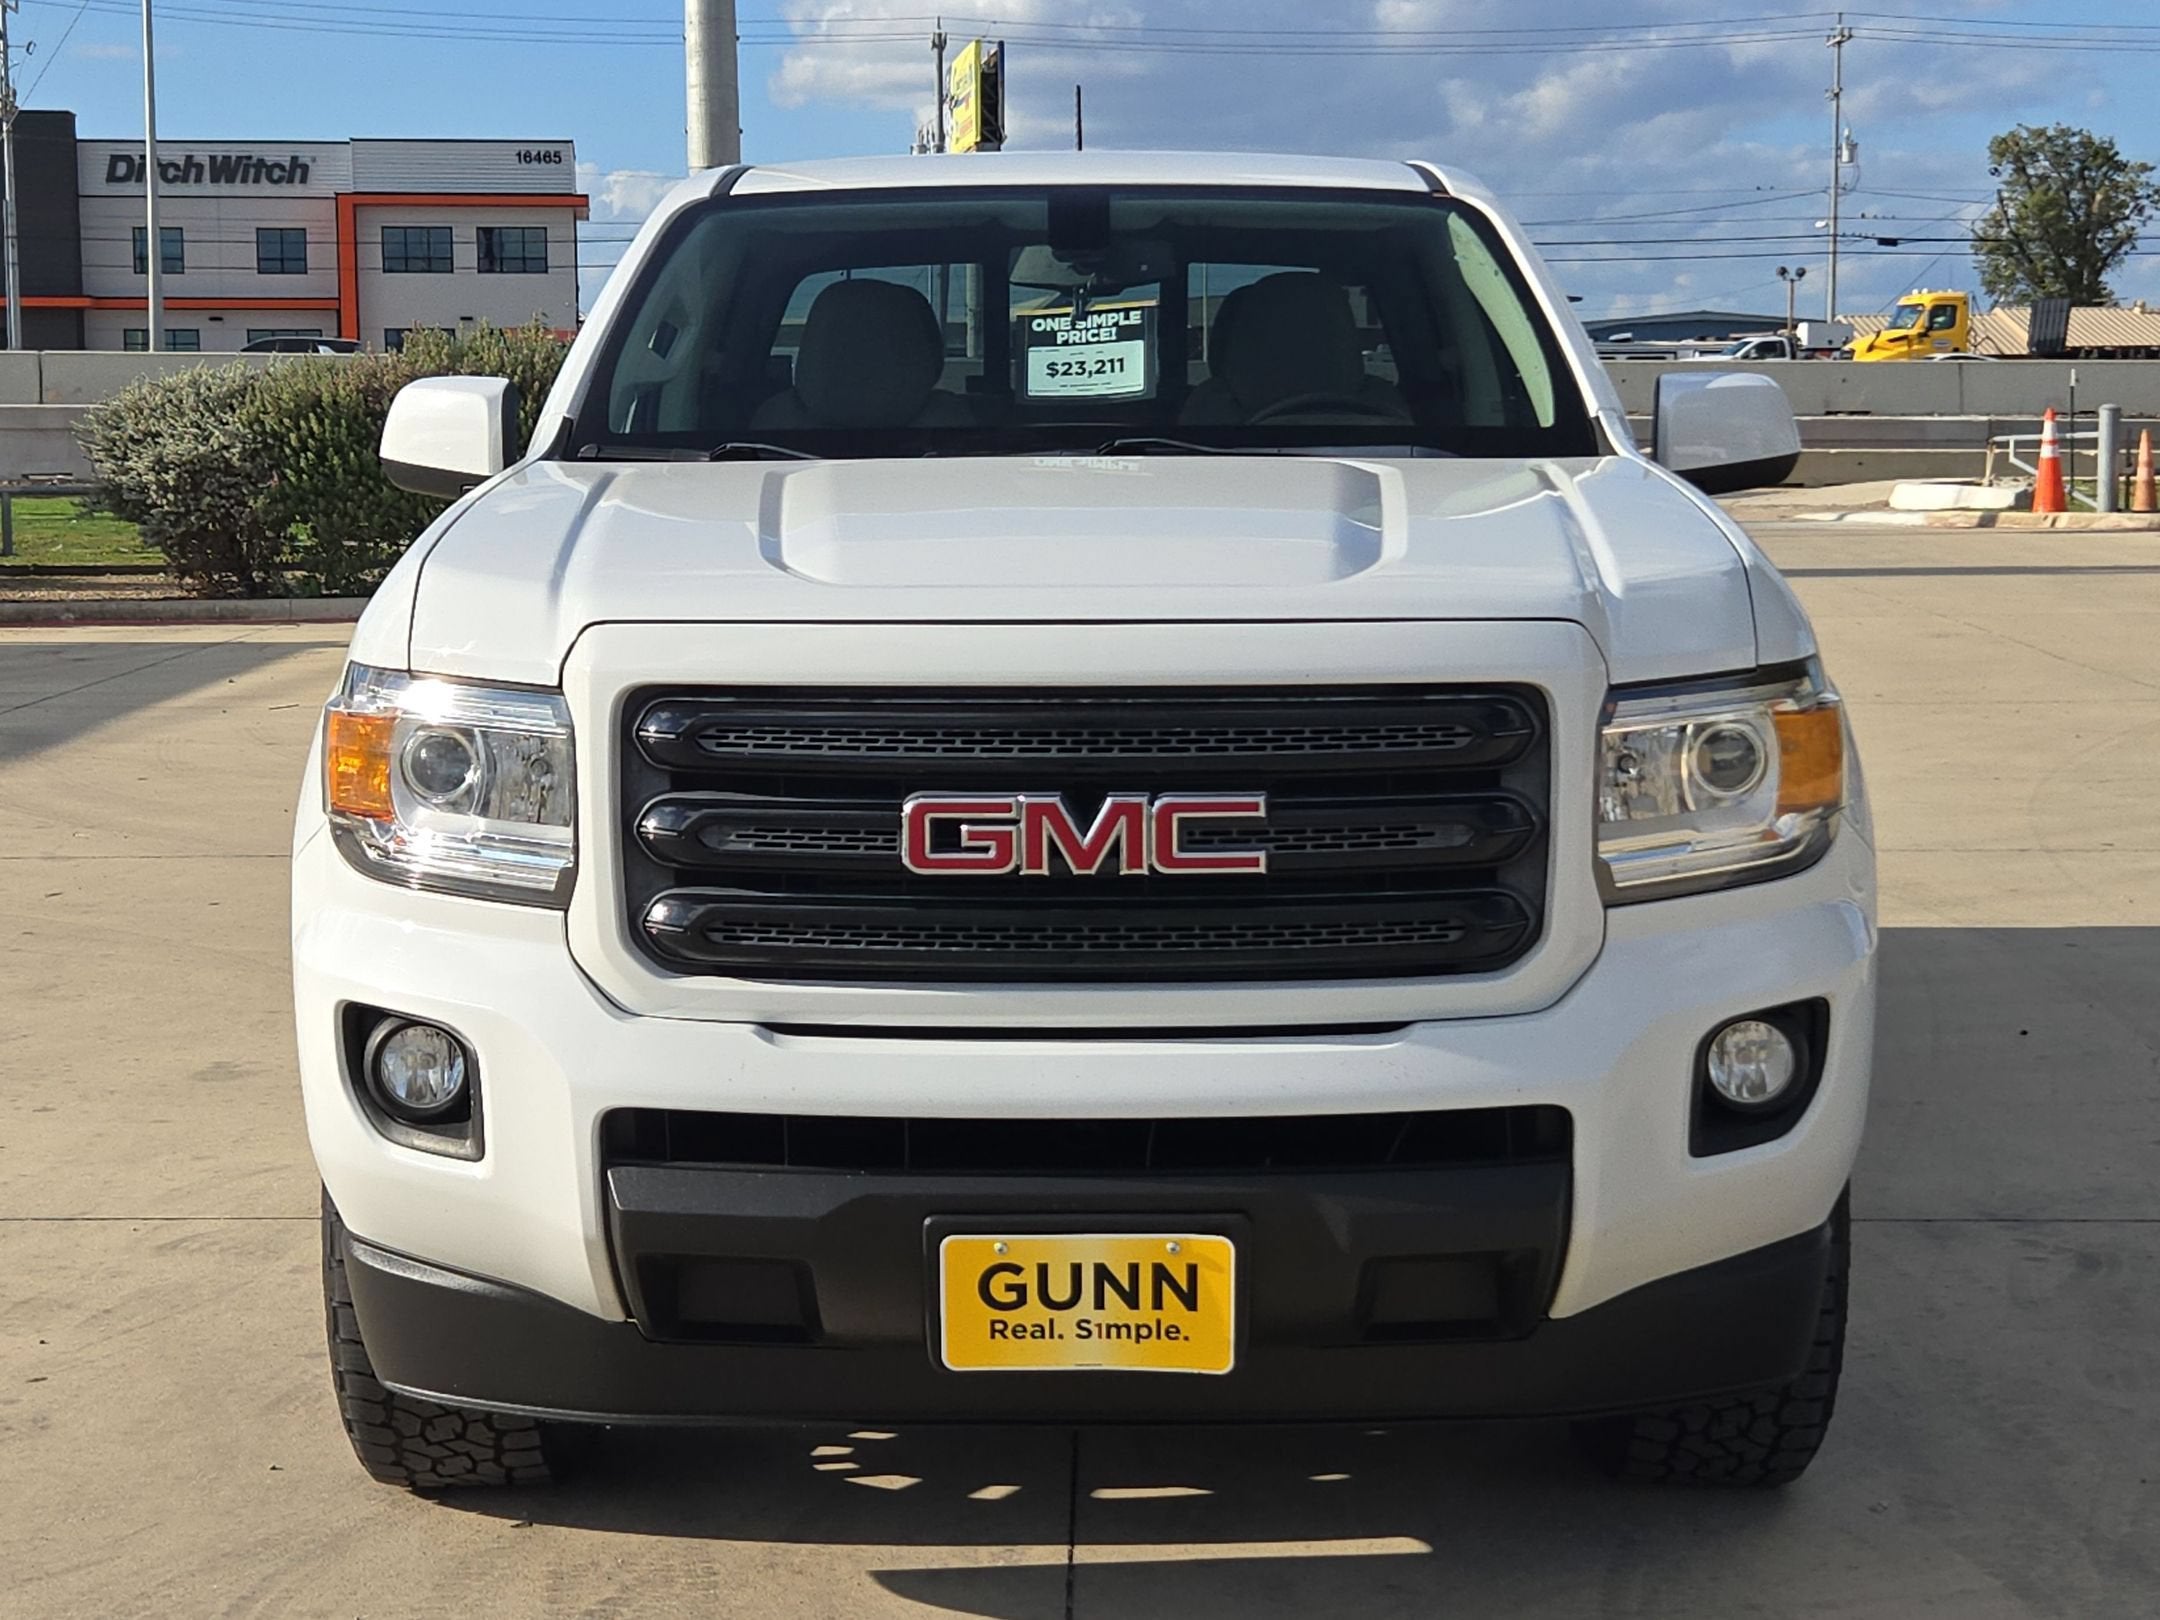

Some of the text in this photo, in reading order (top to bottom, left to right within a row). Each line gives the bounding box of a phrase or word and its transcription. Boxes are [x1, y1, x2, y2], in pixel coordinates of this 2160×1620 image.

[515, 150, 562, 164] 16465
[106, 154, 310, 185] Dich Witch
[1031, 317, 1072, 332] ONE
[1056, 327, 1118, 345] PRICE!
[1045, 357, 1125, 379] $23,211
[901, 791, 1266, 875] GMC
[977, 1262, 1199, 1312] GUNN
[989, 1317, 1065, 1340] Real.
